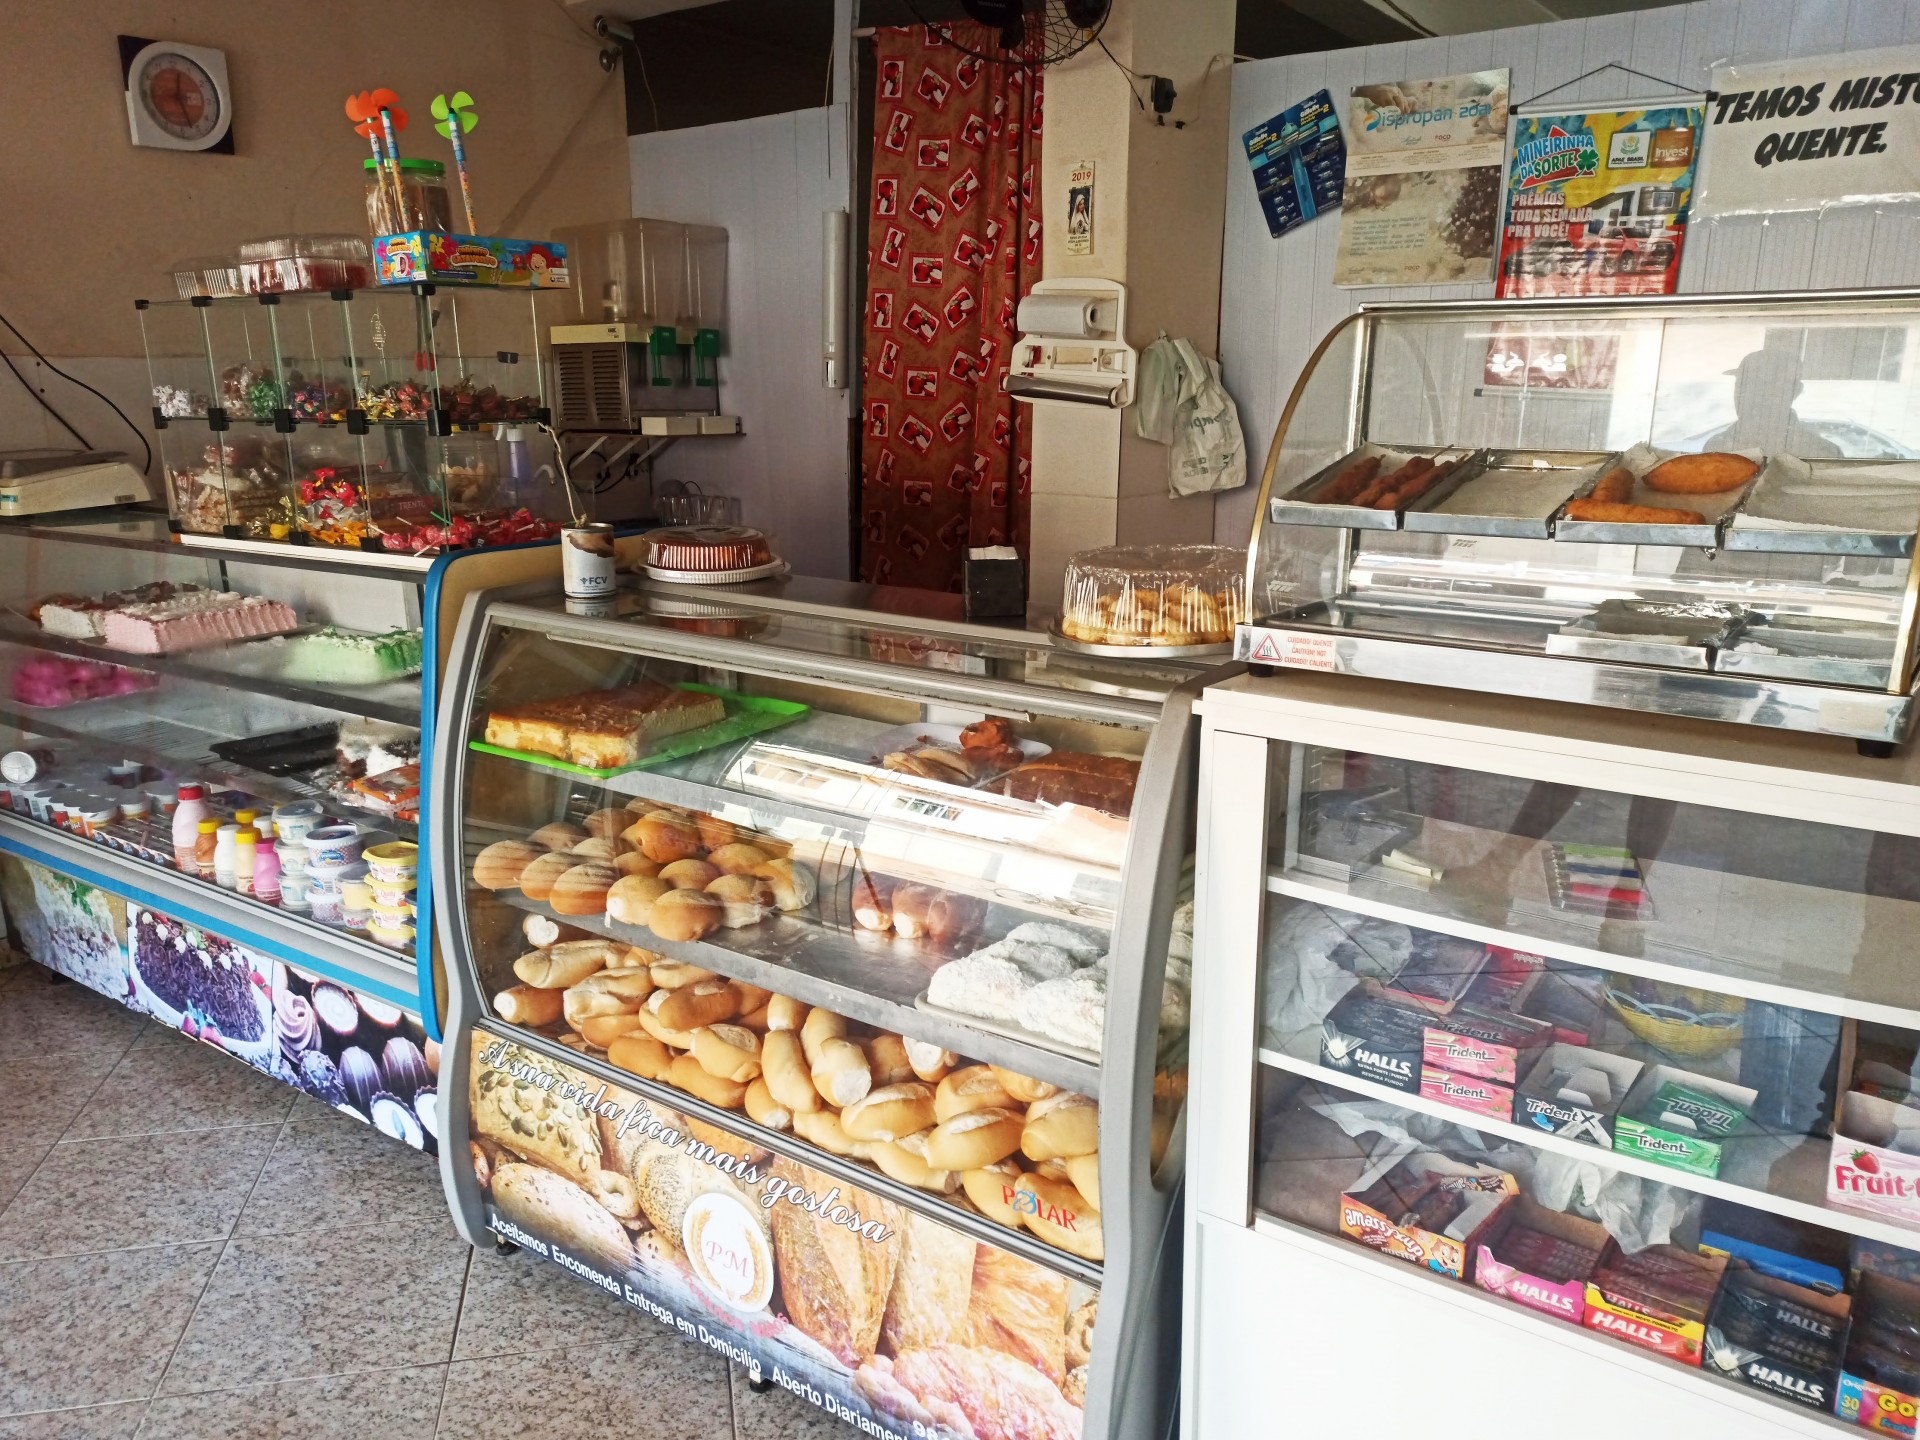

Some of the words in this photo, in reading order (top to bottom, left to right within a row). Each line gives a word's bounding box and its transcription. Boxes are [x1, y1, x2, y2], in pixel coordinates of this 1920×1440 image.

[1459, 103, 1493, 118] 2021
[1713, 82, 1826, 125] TEMOS
[1517, 135, 1595, 166] MINEIRINHA
[1655, 146, 1689, 158] Invest
[1754, 121, 1888, 168] QUENTE.
[1519, 162, 1534, 180] DA
[1533, 152, 1575, 179] SORTE
[1071, 171, 1091, 182] 2019
[1512, 191, 1566, 207] PRÊMIOS
[1510, 209, 1541, 223] TODA
[1541, 206, 1594, 222] SEMANA
[1507, 224, 1533, 238] PRA
[1533, 221, 1570, 238] VOCÊ!
[588, 576, 608, 585] FCV
[1313, 639, 1333, 648] QUENTE
[1446, 1045, 1495, 1060] Trident
[1354, 1048, 1412, 1077] HALLS
[1384, 1077, 1404, 1087] FUNDO
[1443, 1082, 1492, 1099] Trident
[479, 1040, 510, 1069] A
[509, 1059, 560, 1091] sua
[560, 1081, 625, 1121] vida
[616, 1099, 686, 1148] fica
[684, 1138, 767, 1185] mais
[760, 1175, 895, 1243] gostosa
[1638, 1135, 1692, 1154] Trident
[1511, 1280, 1575, 1314] HALLS
[491, 1213, 549, 1257] Aceitamos
[551, 1245, 622, 1297] Encomenda
[624, 1284, 675, 1325] Entrega
[676, 1317, 697, 1338] em
[772, 1365, 822, 1406] Aberto
[824, 1392, 908, 1440] Diariame
[1591, 1311, 1664, 1344] HALLS
[1776, 1309, 1832, 1340] HALLS
[1748, 1363, 1825, 1402] HALLS
[1841, 1395, 1860, 1411] 30
